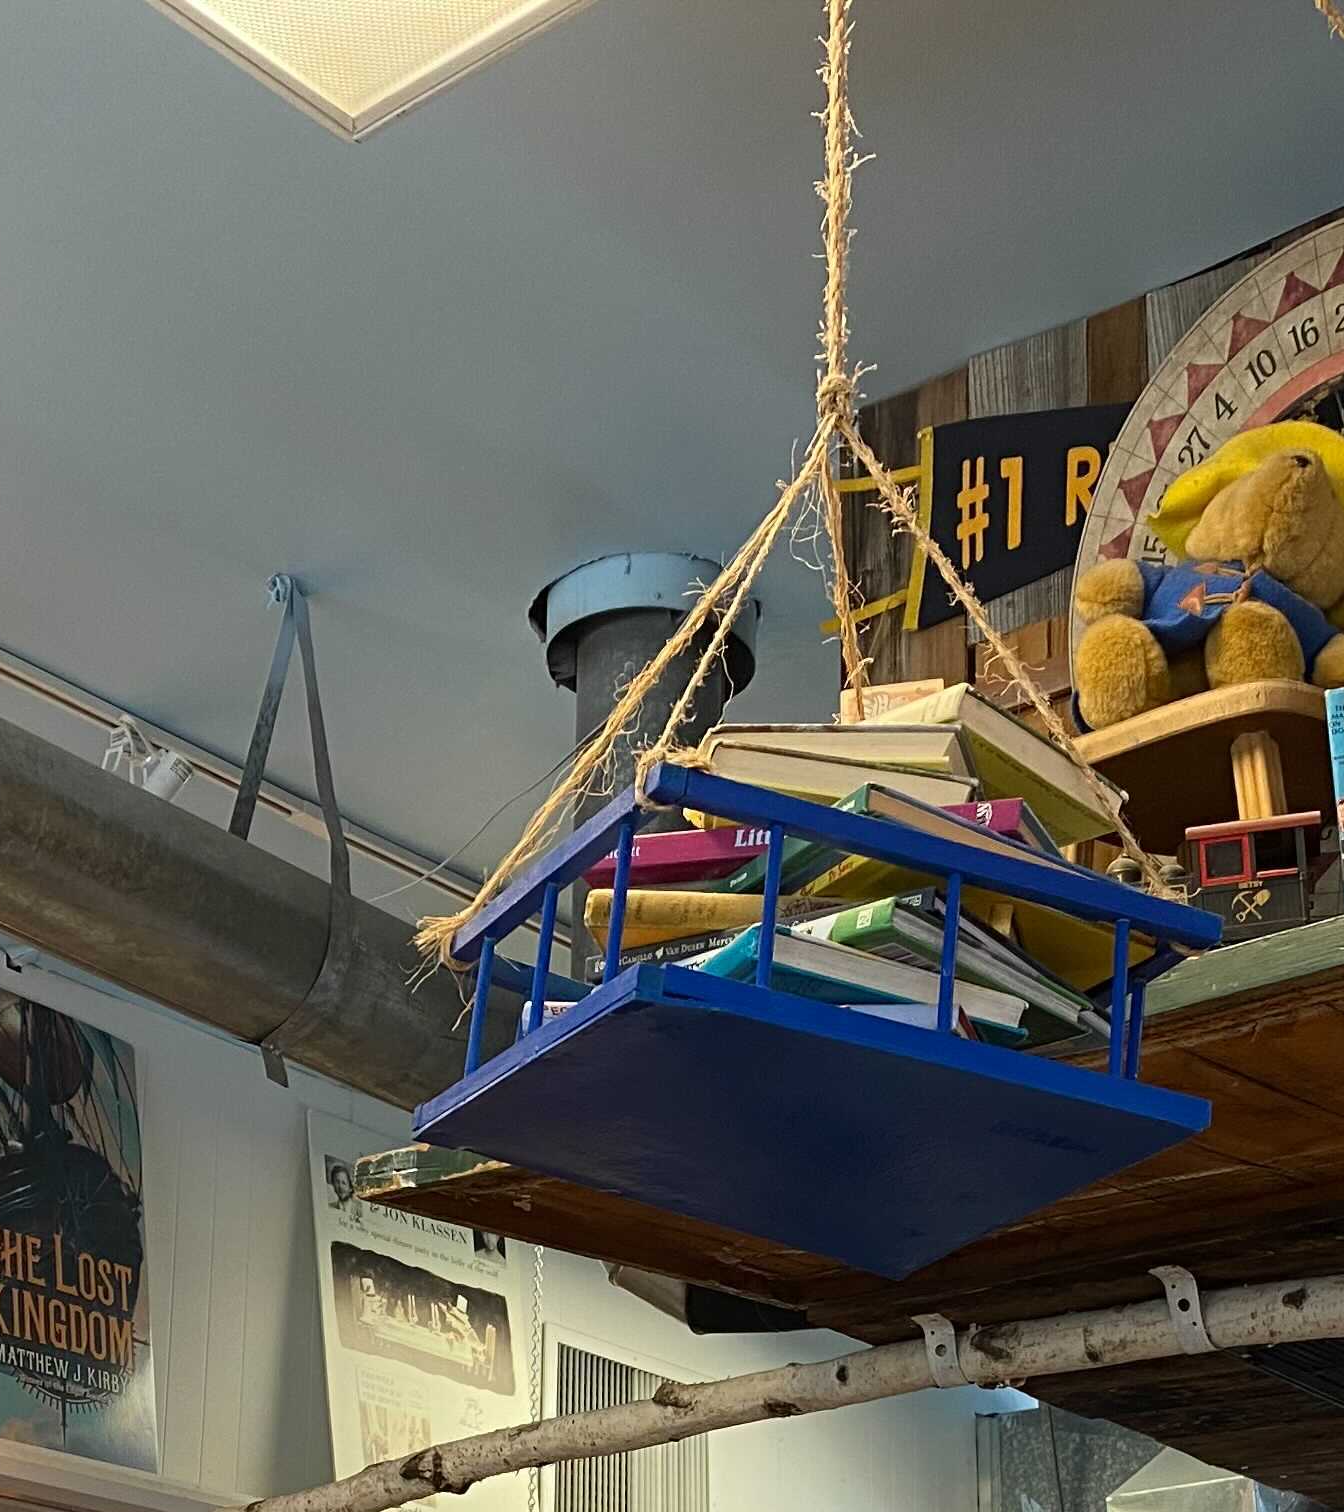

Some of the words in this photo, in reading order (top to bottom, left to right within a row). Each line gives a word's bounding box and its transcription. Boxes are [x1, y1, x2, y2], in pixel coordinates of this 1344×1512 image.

[1178, 424, 1213, 468] 27
[1212, 391, 1240, 422] 4
[1243, 349, 1277, 387] 10
[1287, 316, 1322, 355] 16
[956, 445, 1023, 569] #1
[411, 1215, 469, 1245] KLASSEN
[53, 1232, 133, 1313] LOST
[87, 1366, 130, 1394] KIRBY
